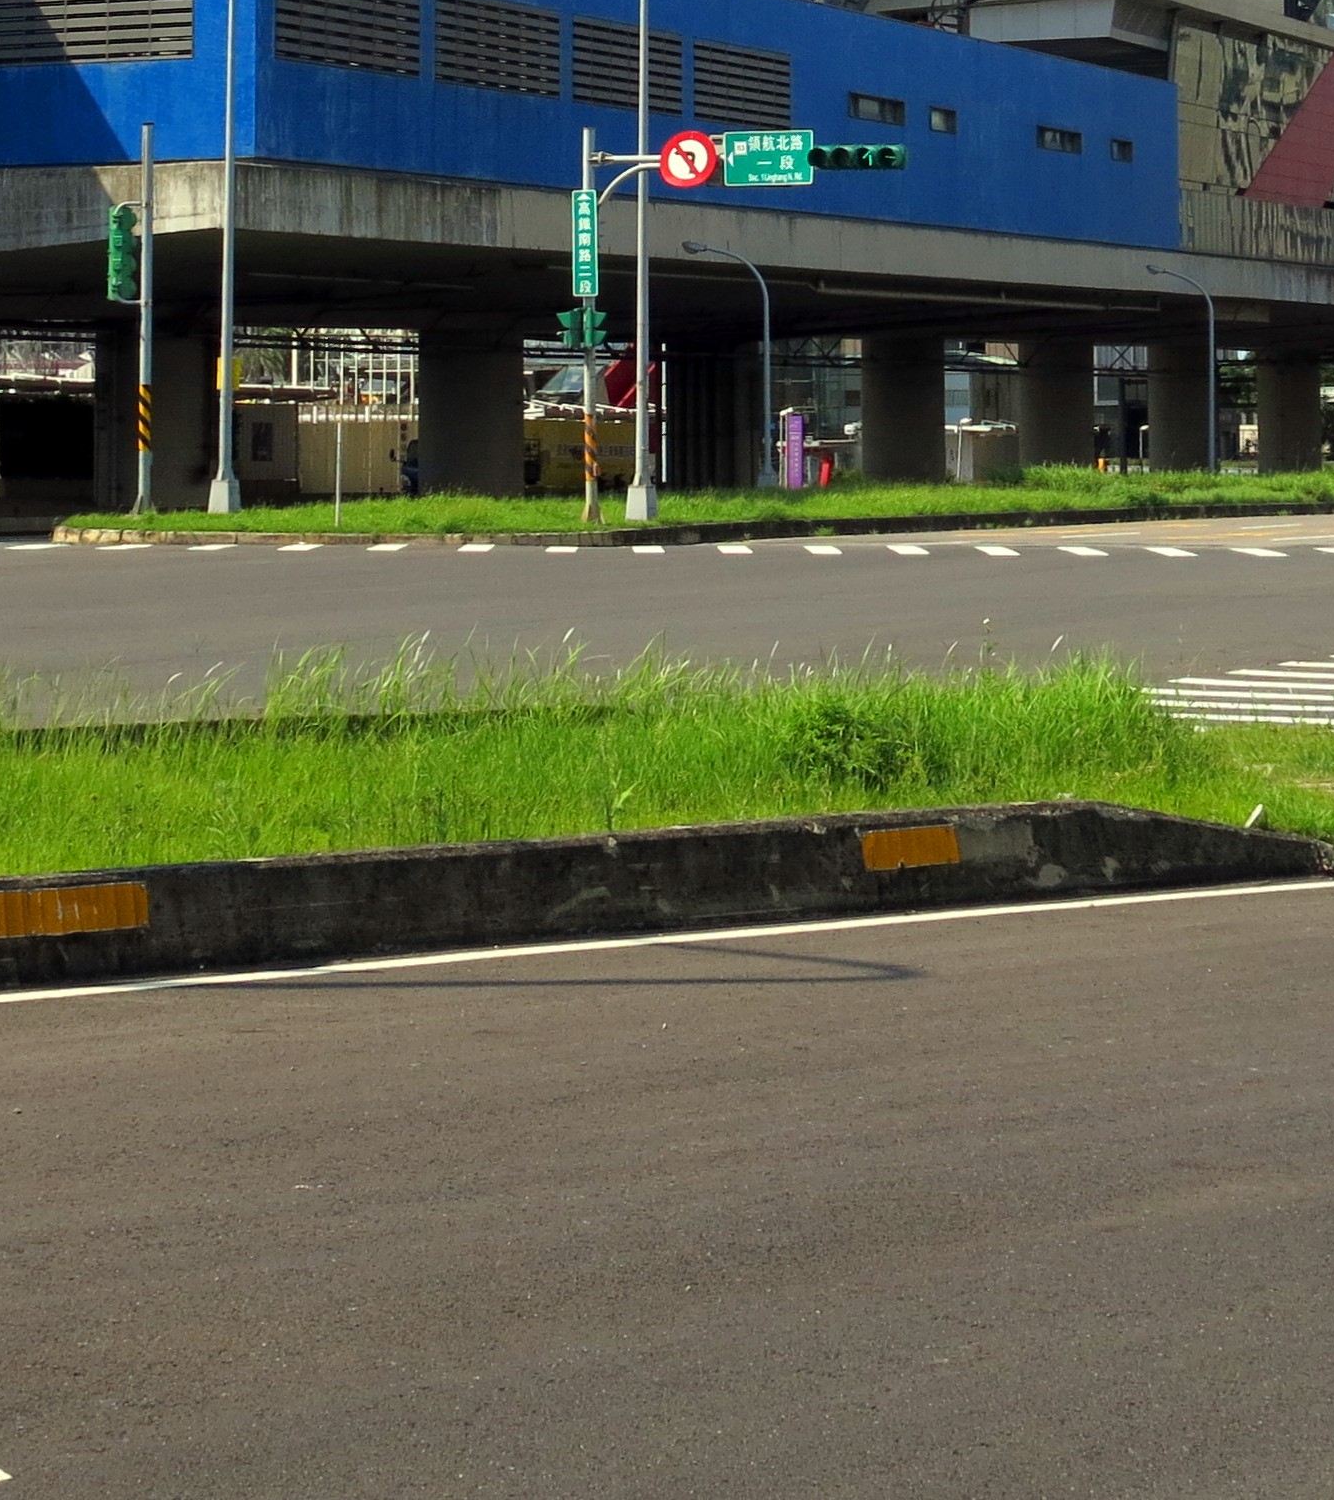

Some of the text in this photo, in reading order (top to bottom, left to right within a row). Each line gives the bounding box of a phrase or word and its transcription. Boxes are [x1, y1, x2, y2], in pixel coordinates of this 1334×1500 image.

[748, 135, 804, 151] 領航北路
[757, 155, 795, 171] 一段
[578, 201, 593, 293] 高鐵南路二段
